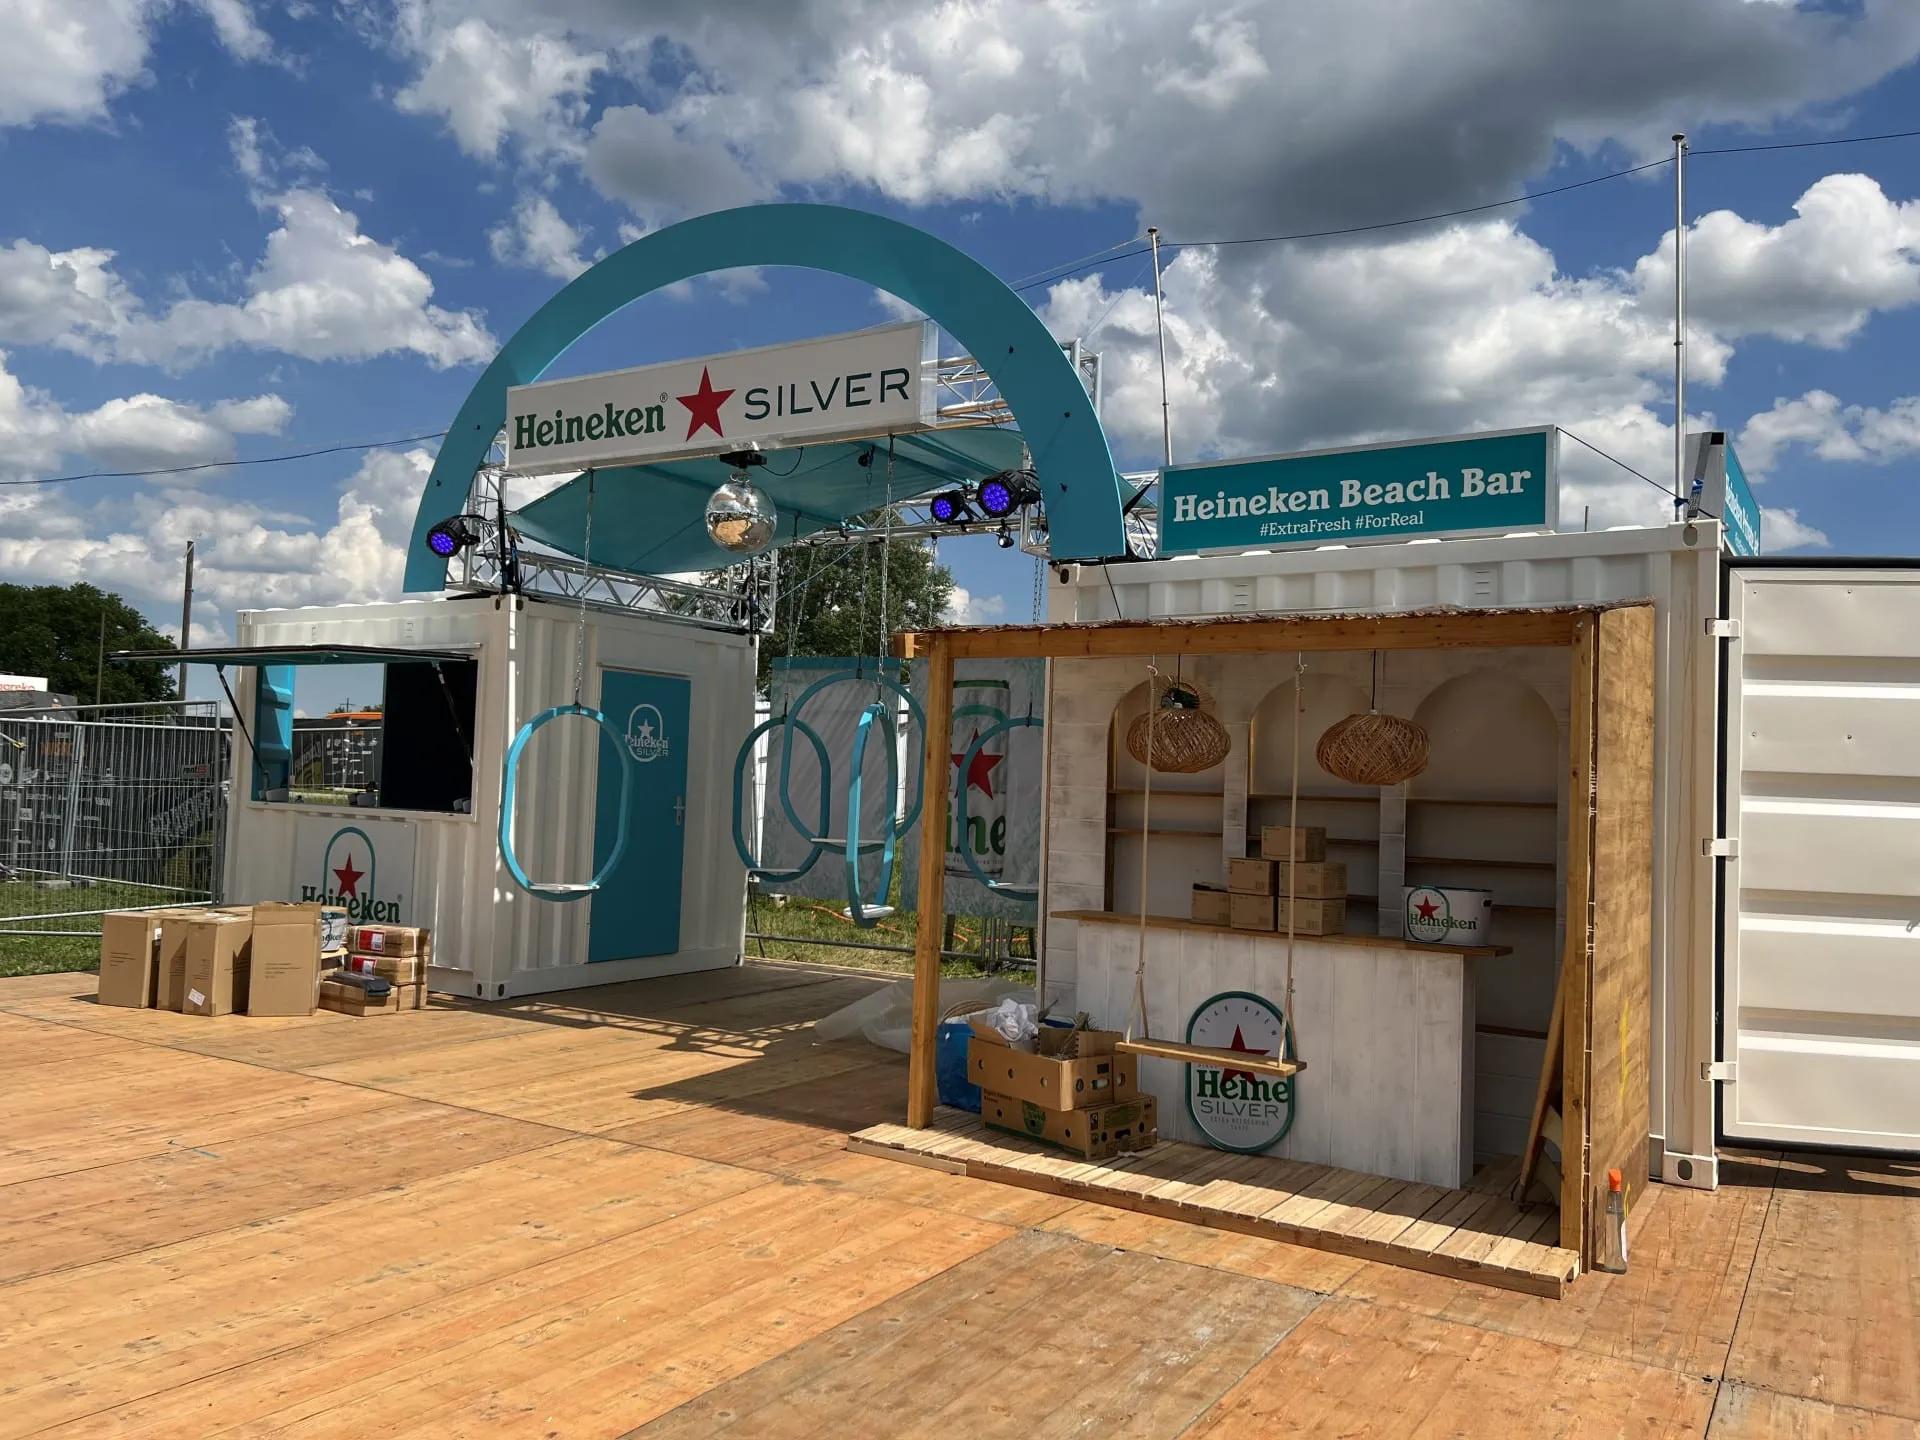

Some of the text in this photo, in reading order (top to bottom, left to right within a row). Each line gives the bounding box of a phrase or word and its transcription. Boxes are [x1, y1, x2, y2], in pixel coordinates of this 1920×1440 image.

[514, 367, 910, 450] Heineken SILVER
[1173, 467, 1532, 522] Heineken Beach Bar
[1260, 510, 1424, 536] #ExtraFresh #ForReal
[1409, 913, 1477, 930] Heineken
[1196, 1069, 1288, 1103] Heine
[1200, 1100, 1279, 1119] SILVER
